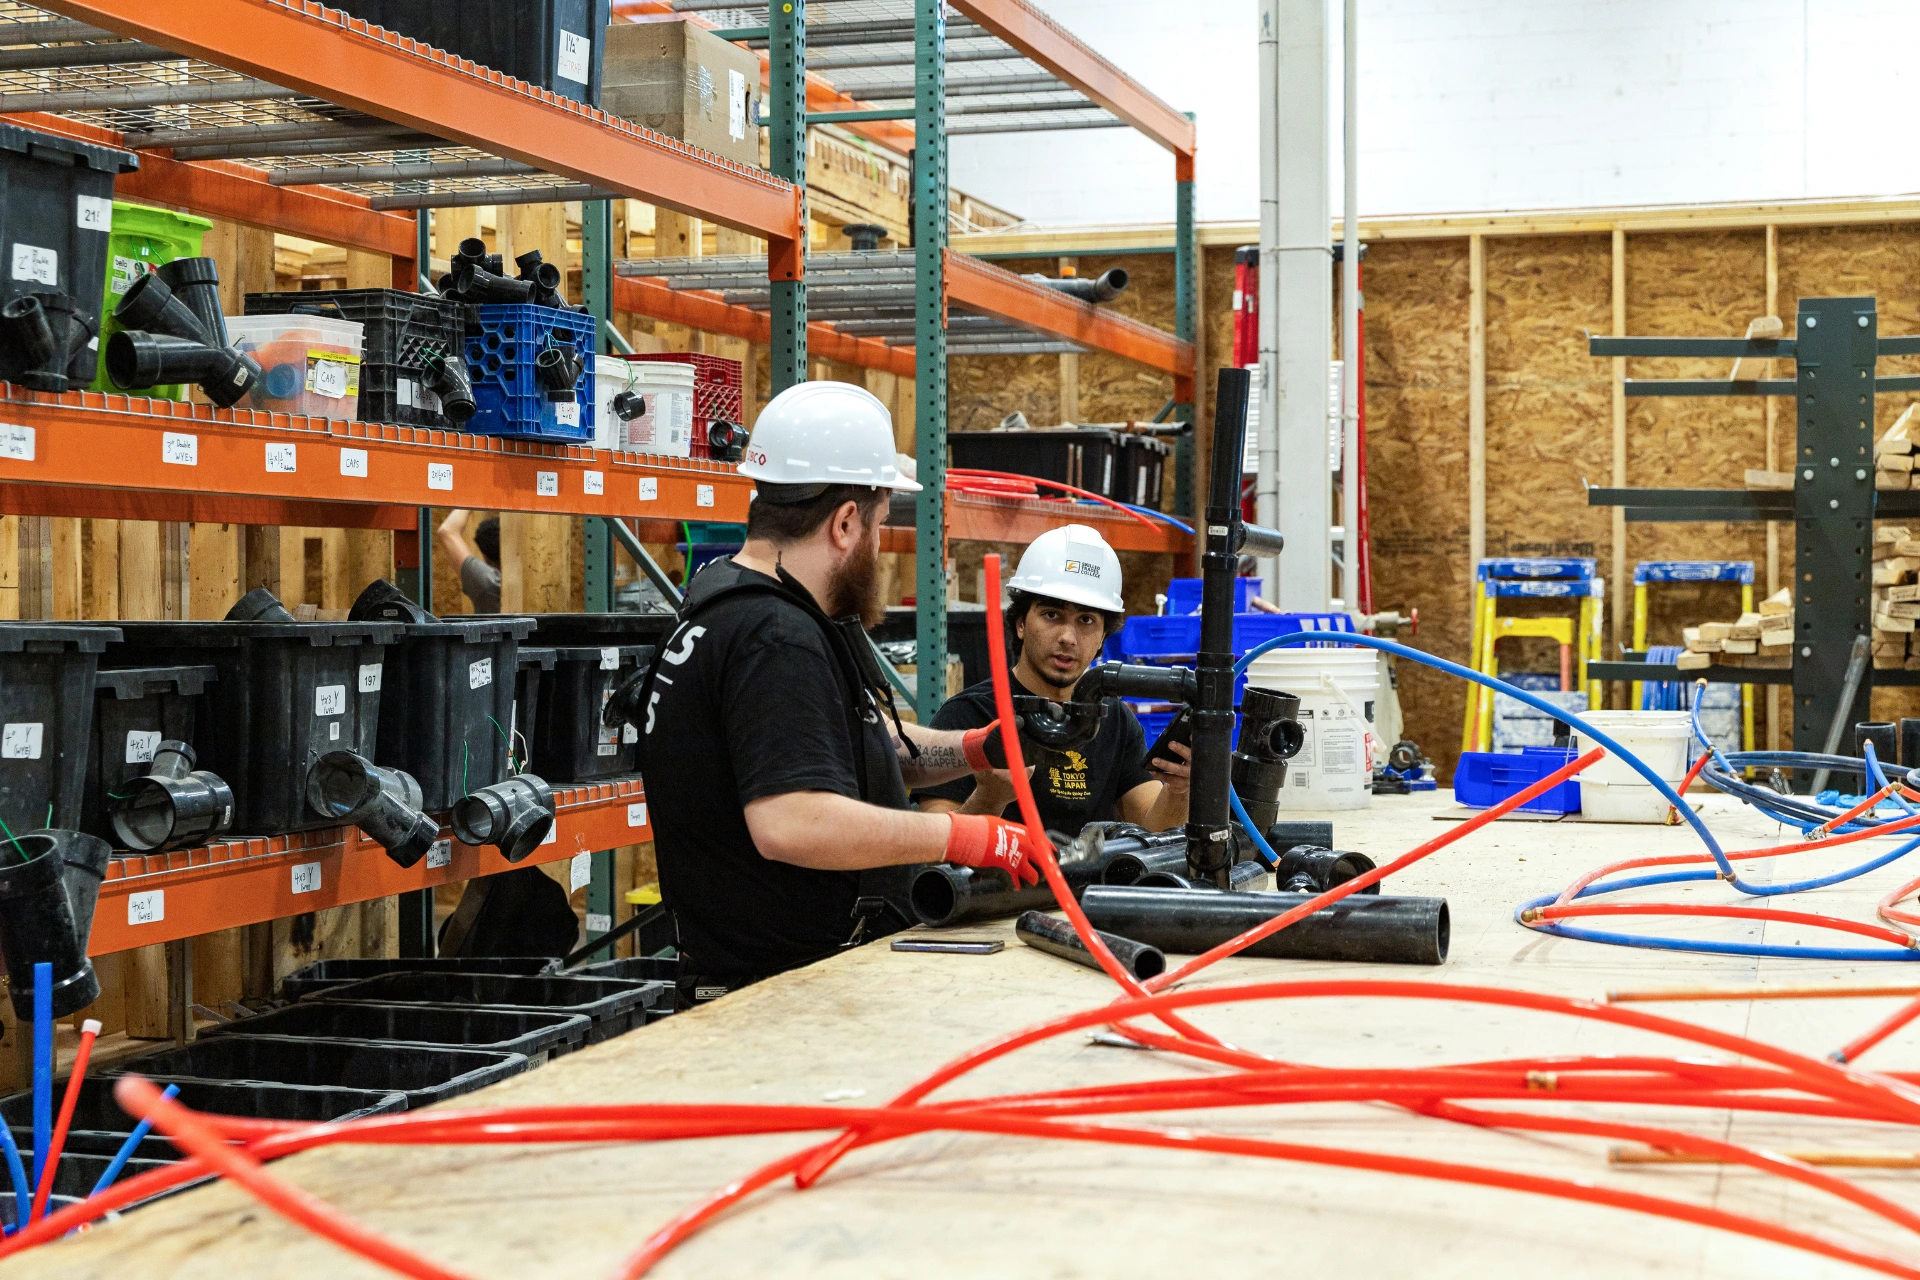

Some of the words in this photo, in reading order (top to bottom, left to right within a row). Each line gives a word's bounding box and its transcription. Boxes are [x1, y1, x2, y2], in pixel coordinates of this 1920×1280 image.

[320, 371, 336, 385] CAPS
[10, 433, 27, 442] Double
[176, 438, 191, 449] Double
[9, 445, 23, 455] WYE
[345, 458, 360, 468] CAPS
[364, 675, 376, 686] 197
[333, 690, 340, 707] Y
[26, 727, 32, 743] Y
[130, 738, 144, 751] 4x2
[147, 734, 153, 749] Y
[930, 746, 956, 758] GEAR
[1062, 772, 1086, 780] TOKYO
[1064, 781, 1087, 789] JAPAN
[294, 872, 306, 885] 4x3
[308, 866, 314, 884] Y
[131, 901, 145, 912] 4x2
[147, 896, 153, 909] Y
